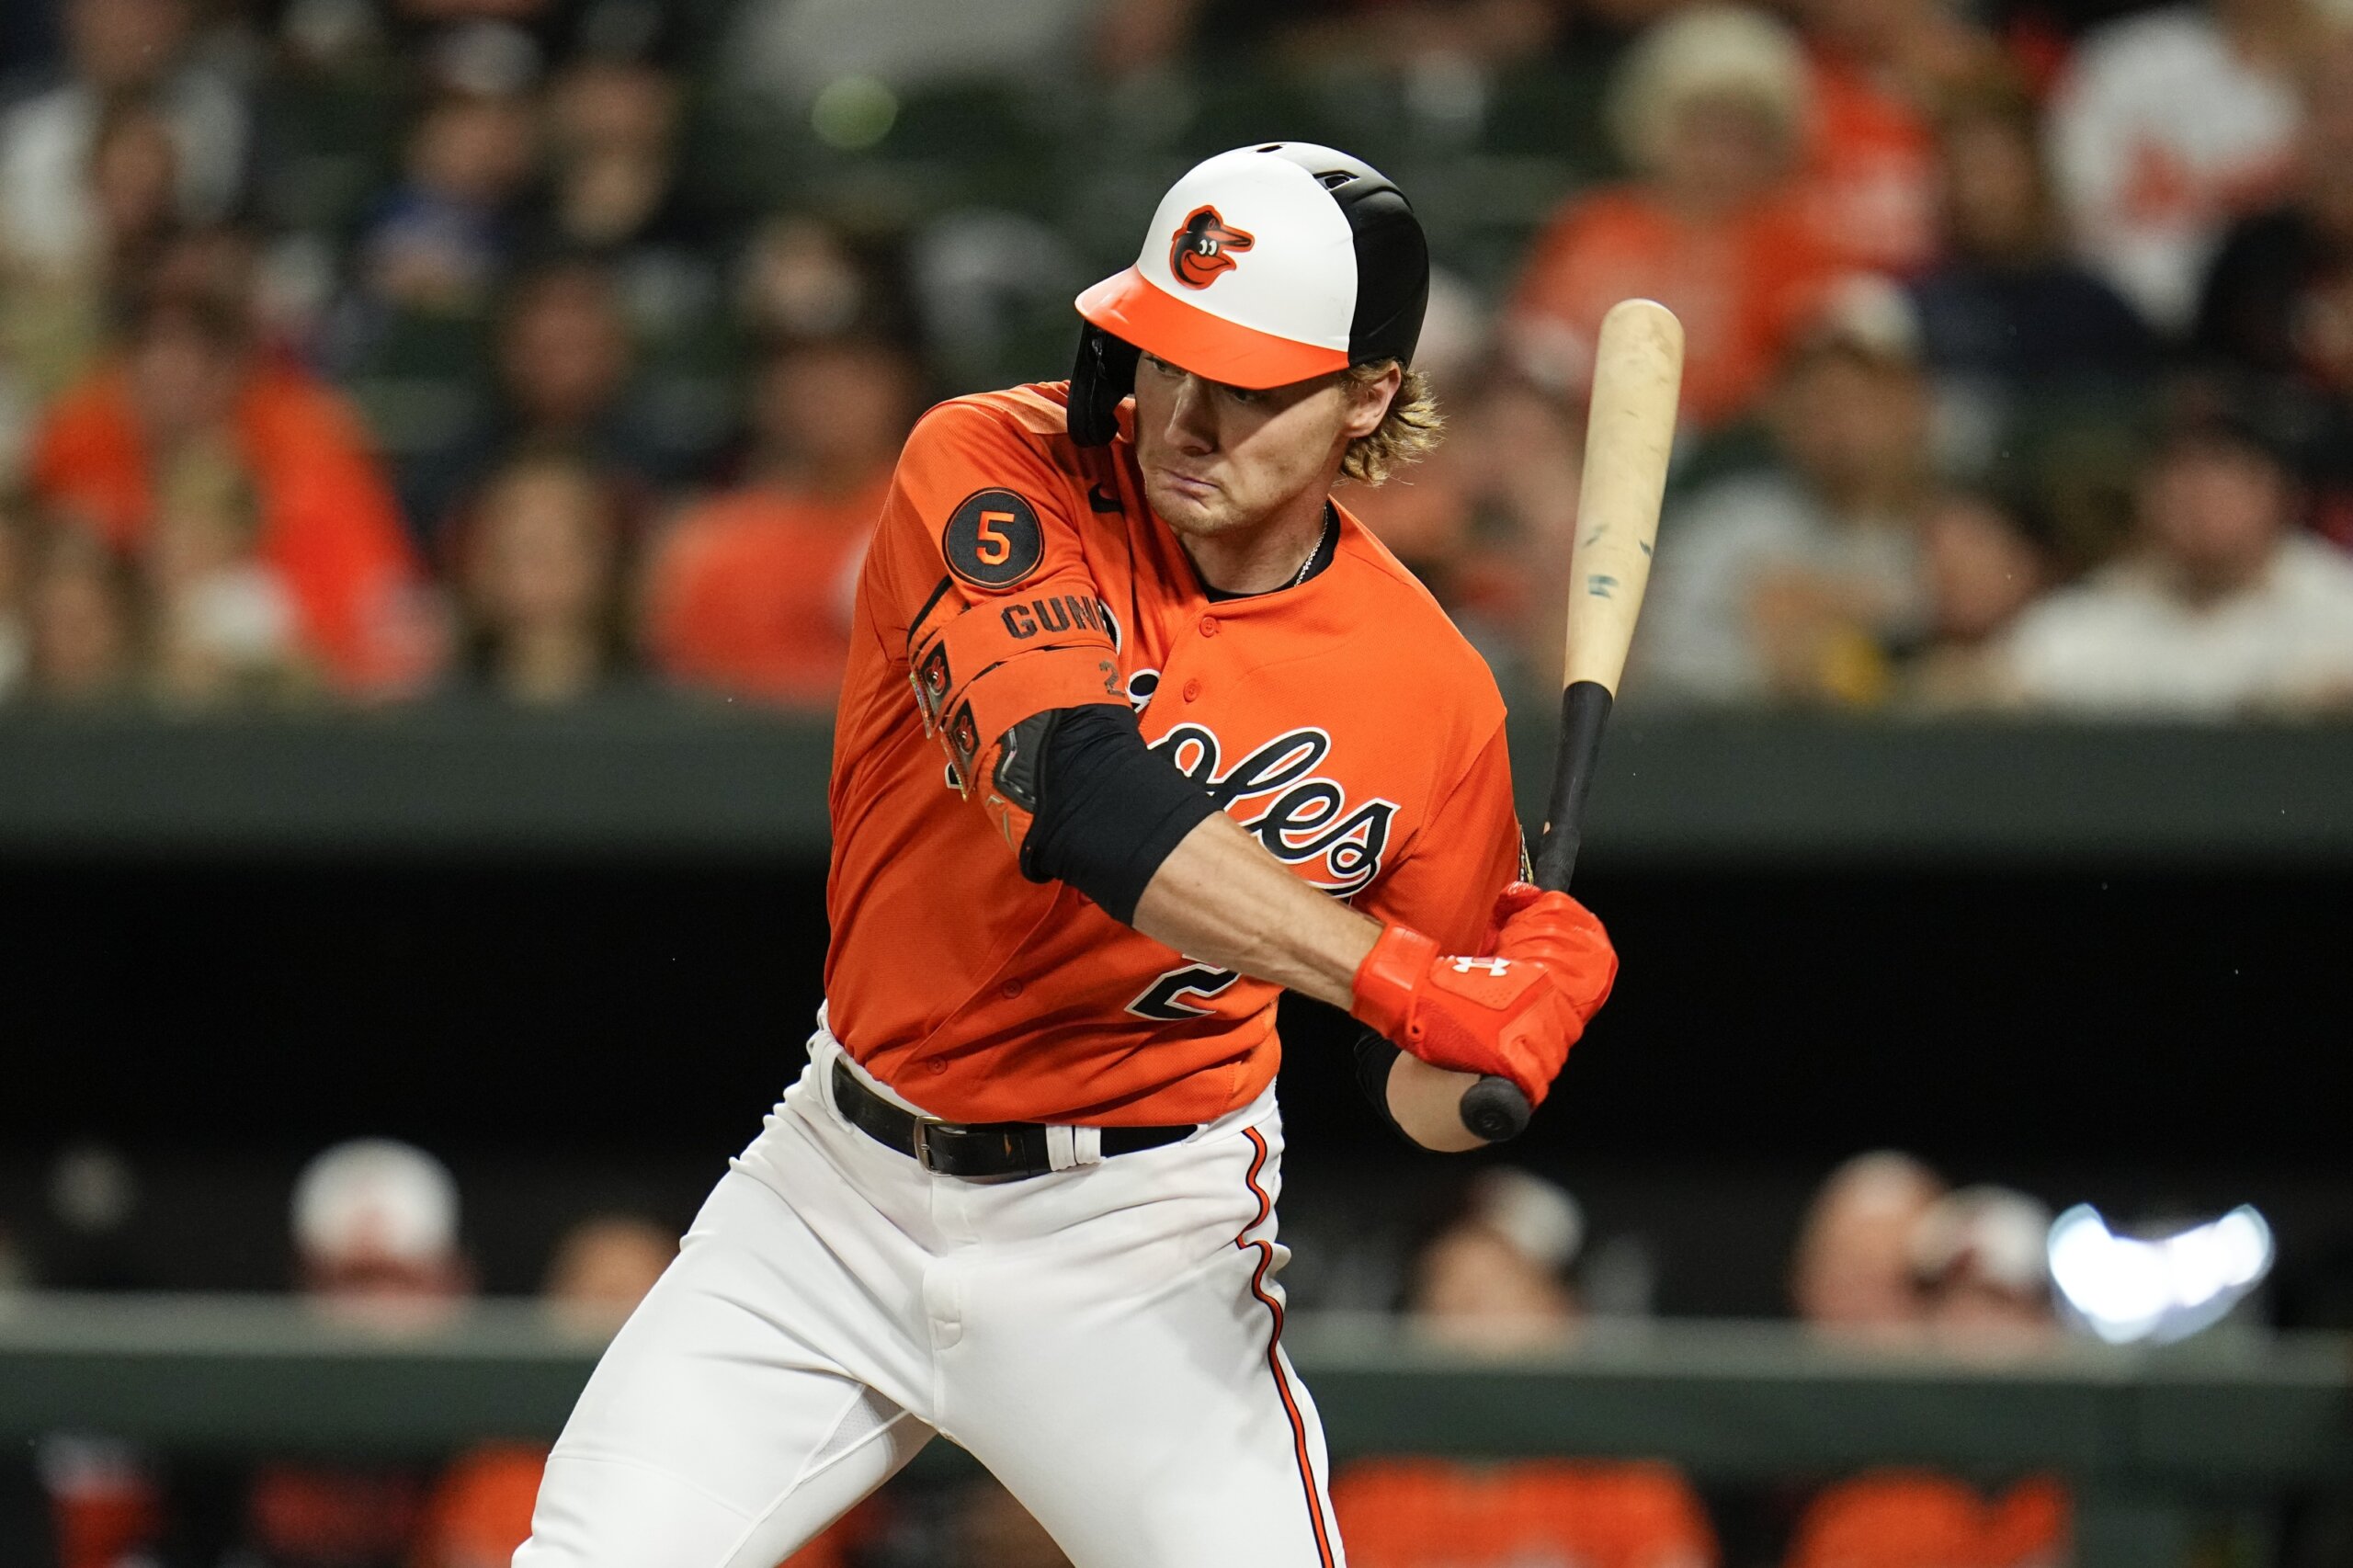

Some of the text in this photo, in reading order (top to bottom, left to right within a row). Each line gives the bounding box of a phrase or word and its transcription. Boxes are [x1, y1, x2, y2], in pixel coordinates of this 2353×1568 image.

[976, 510, 1015, 565] 5
[1000, 595, 1110, 640] GUN
[1098, 660, 1126, 699] 2
